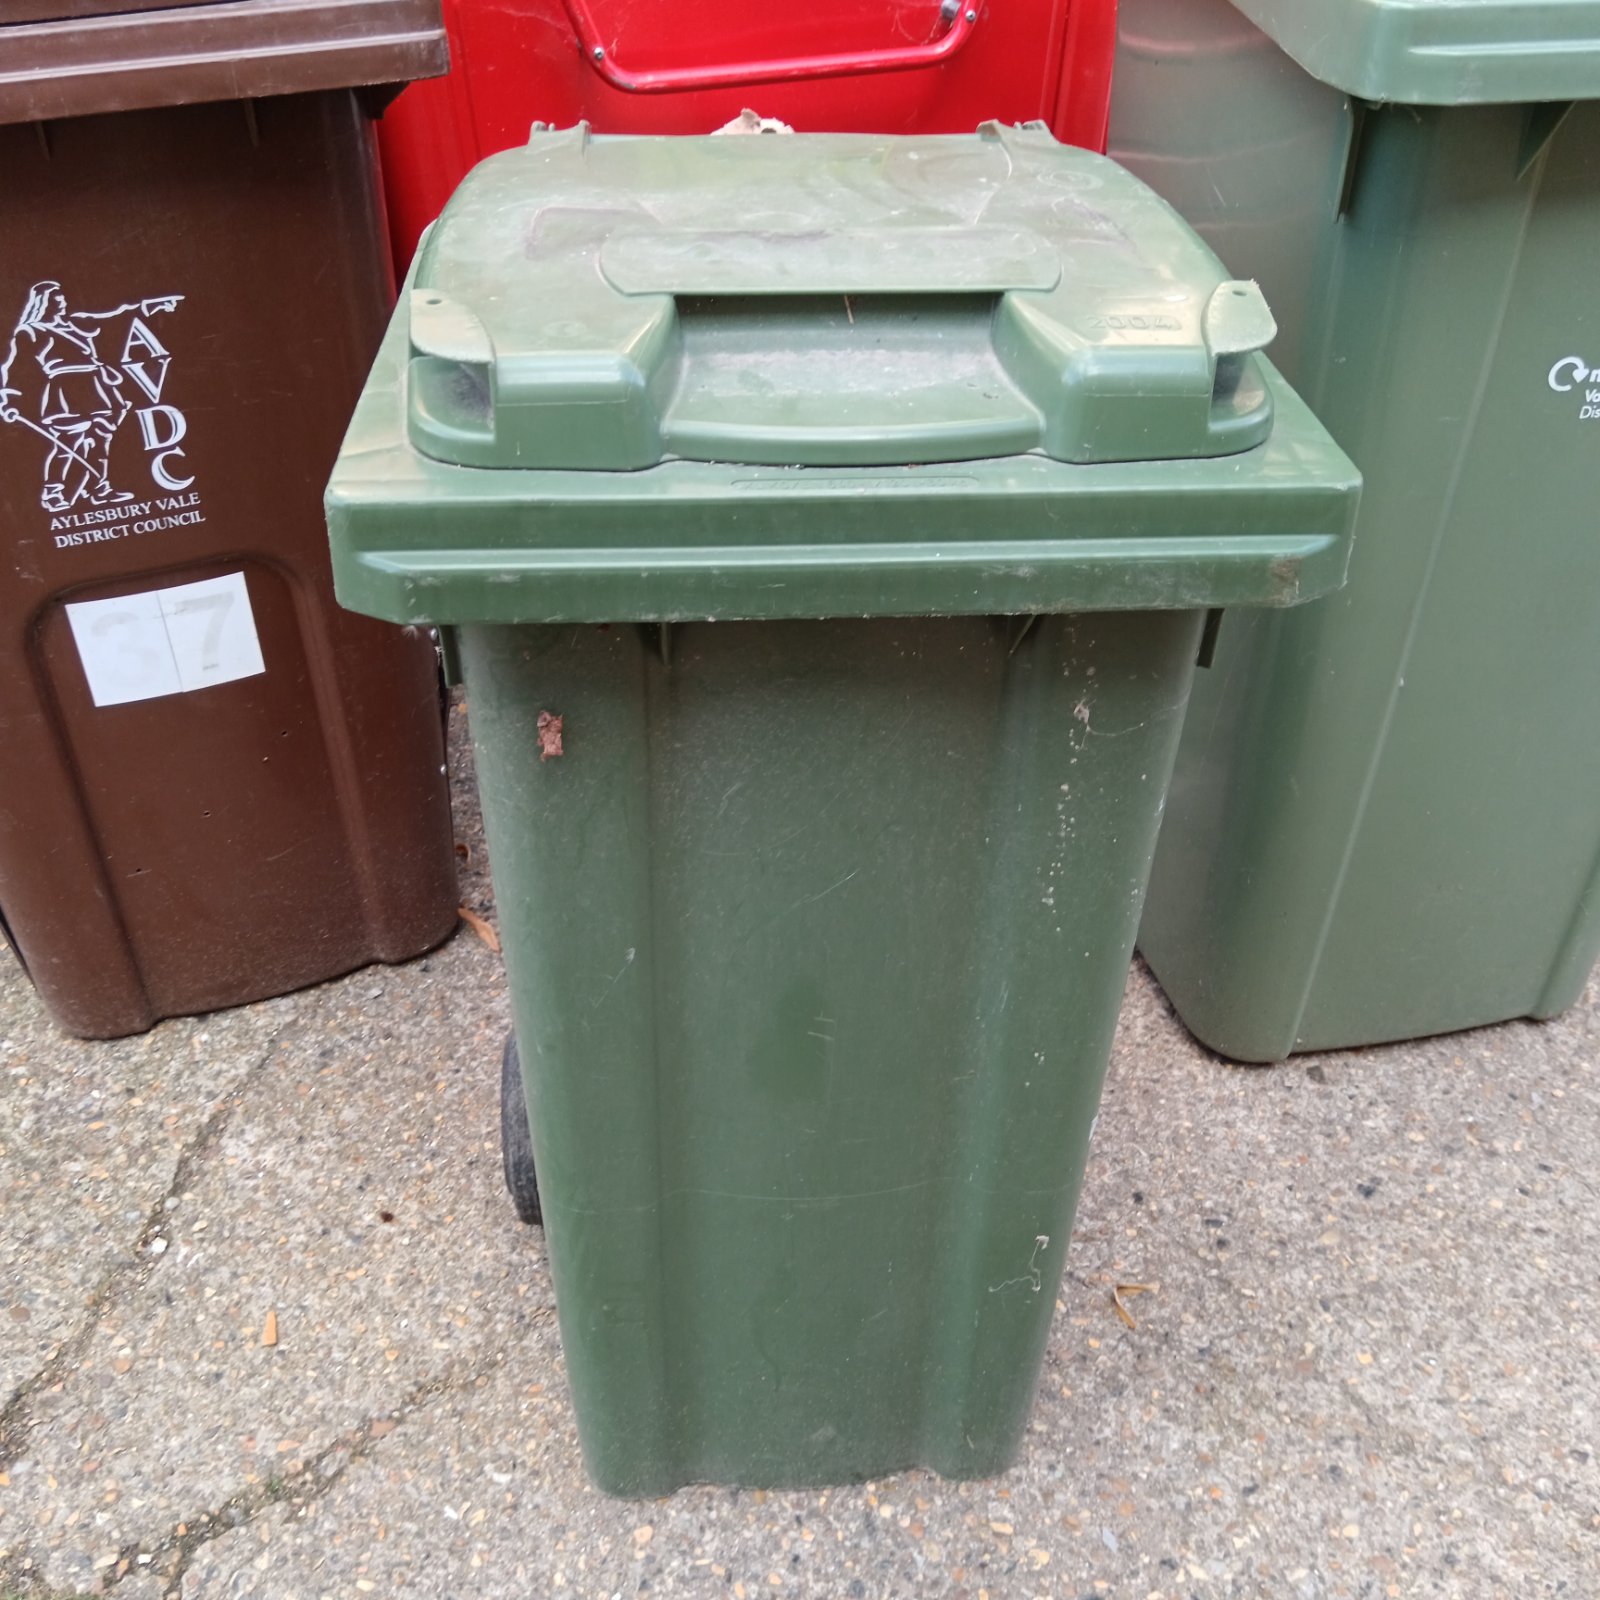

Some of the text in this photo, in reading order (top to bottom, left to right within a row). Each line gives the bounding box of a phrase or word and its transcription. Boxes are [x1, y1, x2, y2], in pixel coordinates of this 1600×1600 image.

[50, 492, 201, 531] AYLESBURY VALE
[54, 511, 206, 548] DISTRICT COUNCIL
